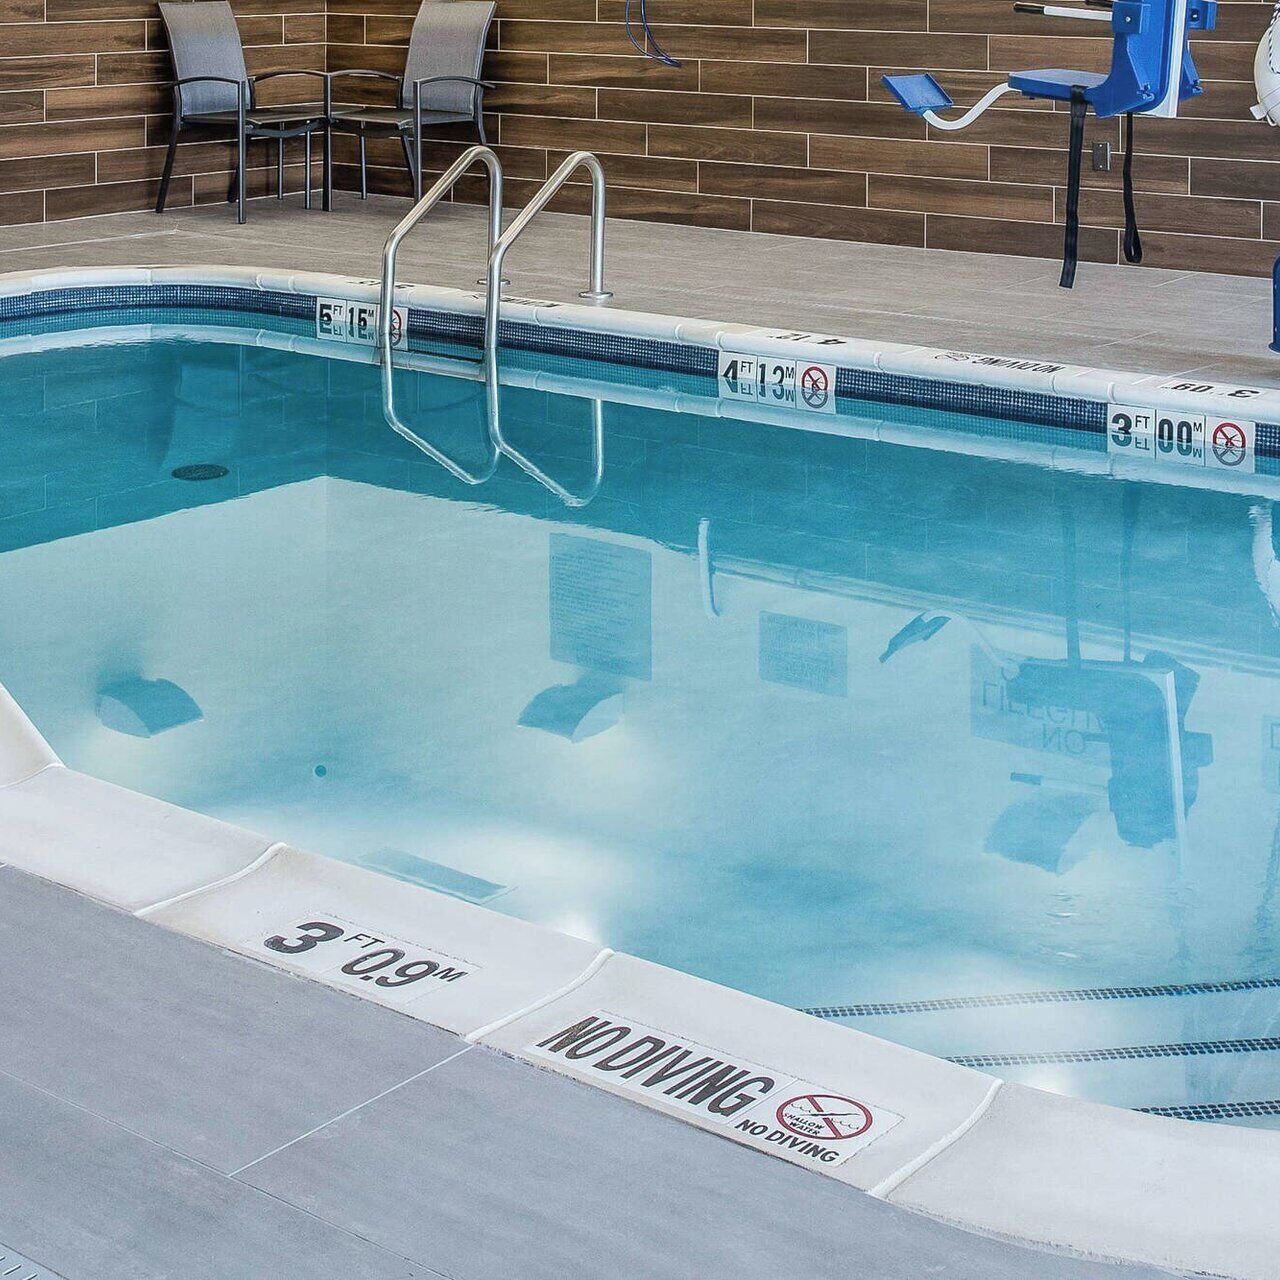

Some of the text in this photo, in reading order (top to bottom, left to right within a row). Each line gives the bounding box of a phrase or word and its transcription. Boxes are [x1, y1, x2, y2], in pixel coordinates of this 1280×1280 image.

[333, 305, 343, 316] FT
[368, 309, 374, 318] M
[741, 361, 754, 373] FT
[785, 366, 795, 379] M
[1135, 415, 1151, 429] FT
[1193, 421, 1203, 433] M
[264, 921, 468, 988] 3 FT 0.9 M
[536, 1016, 775, 1117] NO DIVING
[783, 1113, 826, 1130] SHALLOW
[789, 1121, 821, 1136] WATER
[734, 1118, 840, 1162] NO DIVING
